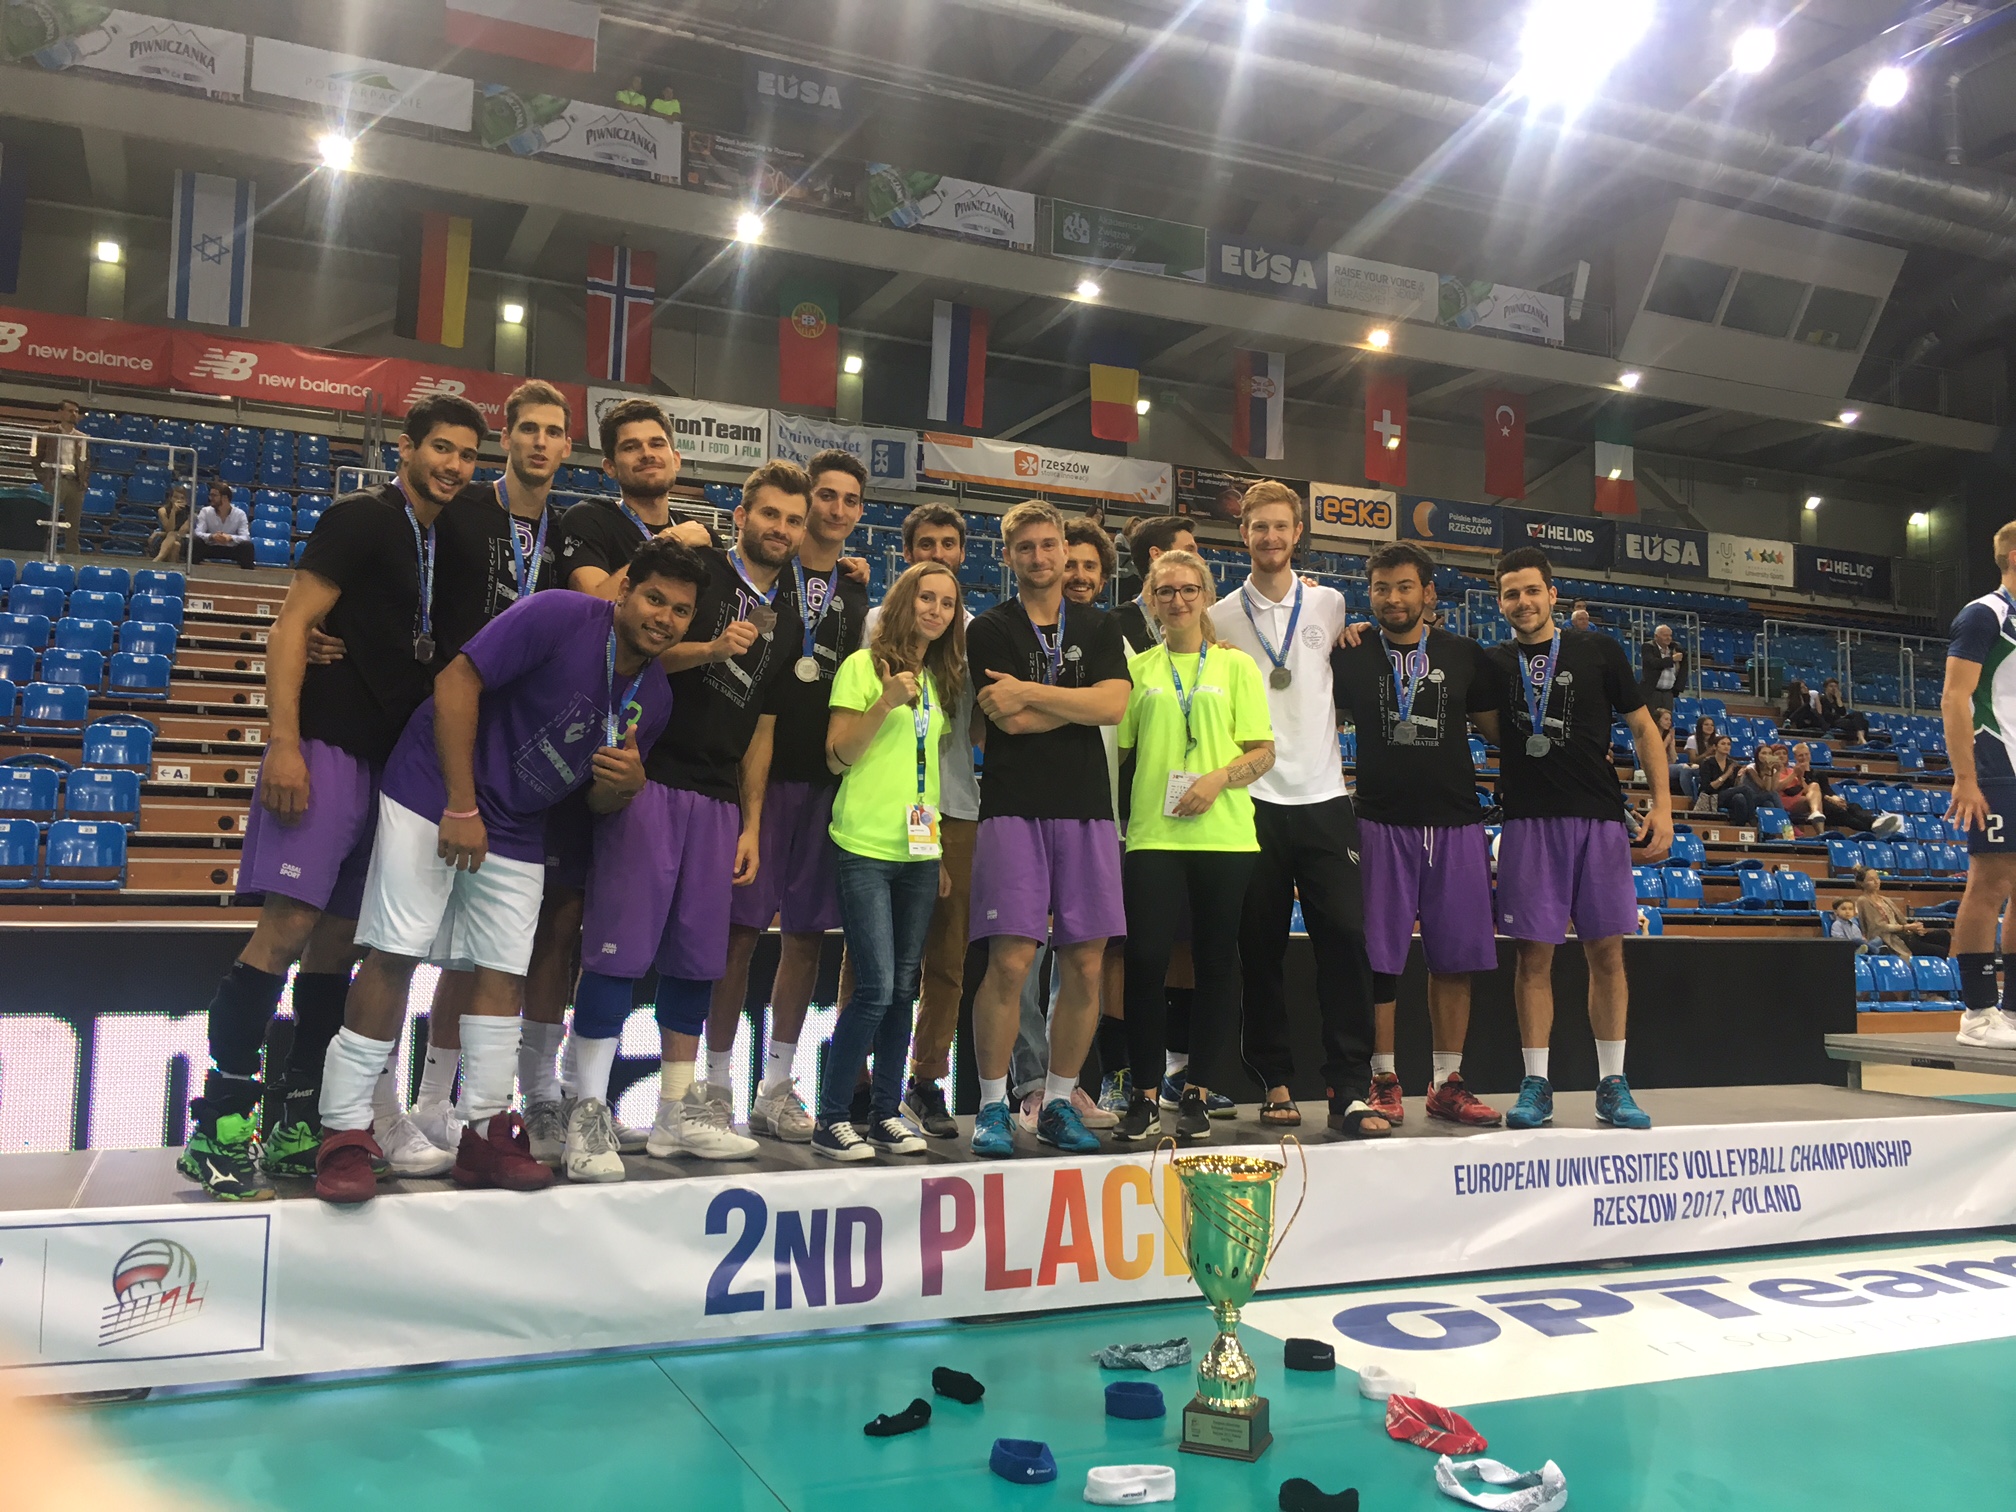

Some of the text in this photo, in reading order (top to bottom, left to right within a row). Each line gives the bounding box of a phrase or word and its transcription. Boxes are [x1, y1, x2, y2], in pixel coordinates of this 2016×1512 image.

[130, 38, 215, 74] PIWNICZANKA
[757, 70, 842, 110] EUSA
[586, 127, 657, 160] PIWNICZANKA
[954, 199, 1015, 230] PIWNICZANKA
[1221, 244, 1318, 290] EUSA
[1334, 265, 1361, 280] RAISE
[1363, 271, 1389, 284] YOUR
[1390, 276, 1416, 290] VOICE
[1503, 303, 1549, 328] PIWNICZANKA
[28, 343, 153, 371] new balance
[258, 371, 373, 398] new balance
[475, 400, 500, 415] ew
[669, 413, 762, 443] ionTeam
[778, 424, 861, 453] Uniwersytet
[708, 441, 730, 455] FOTO
[741, 445, 762, 459] FILM
[1041, 458, 1090, 474] rzeszów
[1323, 497, 1391, 528] eska
[1449, 513, 1492, 525] Polskie Radio
[1448, 522, 1493, 536] RZESZÓW
[1547, 525, 1595, 544] HELIOS
[1625, 533, 1701, 566] EUSA
[1834, 563, 1874, 579] HELIOS
[202, 602, 212, 610] M
[807, 577, 828, 612] 6
[1389, 649, 1430, 680] 10
[1529, 654, 1549, 686] 8
[1439, 687, 1449, 738] TOULOUSE
[1565, 690, 1576, 739] TOULOUSE
[1986, 813, 2005, 843] 2
[279, 868, 301, 880] SPORT
[282, 863, 302, 874] CASAL
[1454, 1139, 1912, 1195] EUROPEAN UNIVERSITIES VOLLEYBALL CHAMPIONSHIP
[1593, 1184, 1802, 1226] RZESZOW 2017, POLAND
[703, 1186, 883, 1315] 2ND
